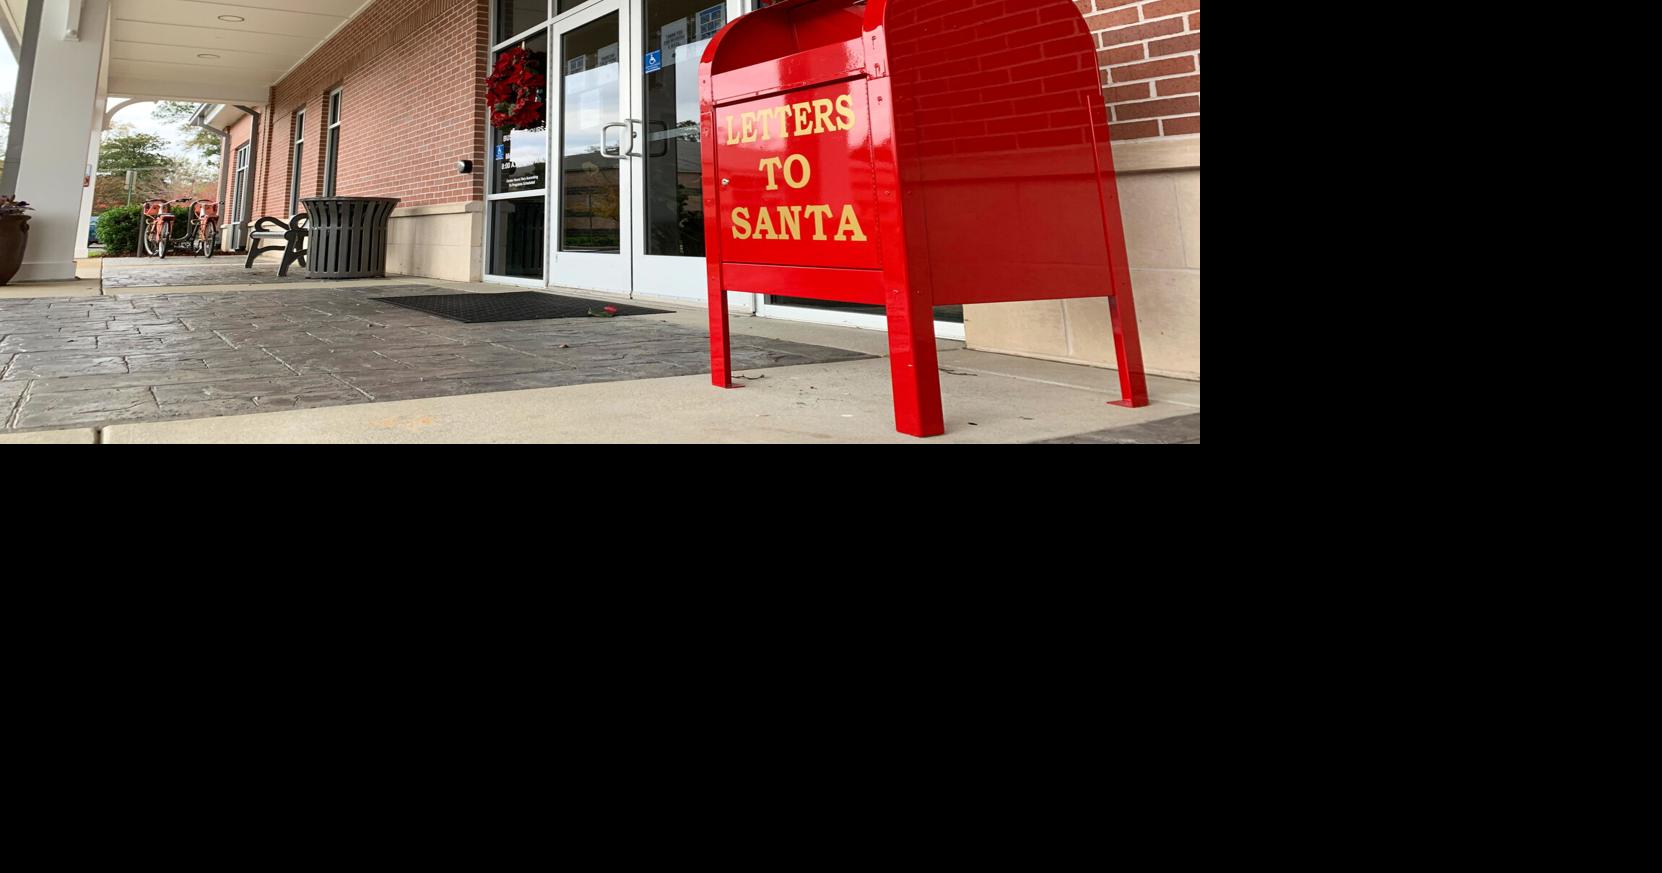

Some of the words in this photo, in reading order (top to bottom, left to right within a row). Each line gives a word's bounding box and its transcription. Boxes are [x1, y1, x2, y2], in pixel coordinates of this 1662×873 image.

[726, 94, 856, 146] LETTERS
[758, 153, 811, 191] TO
[731, 204, 867, 241] SANTA
